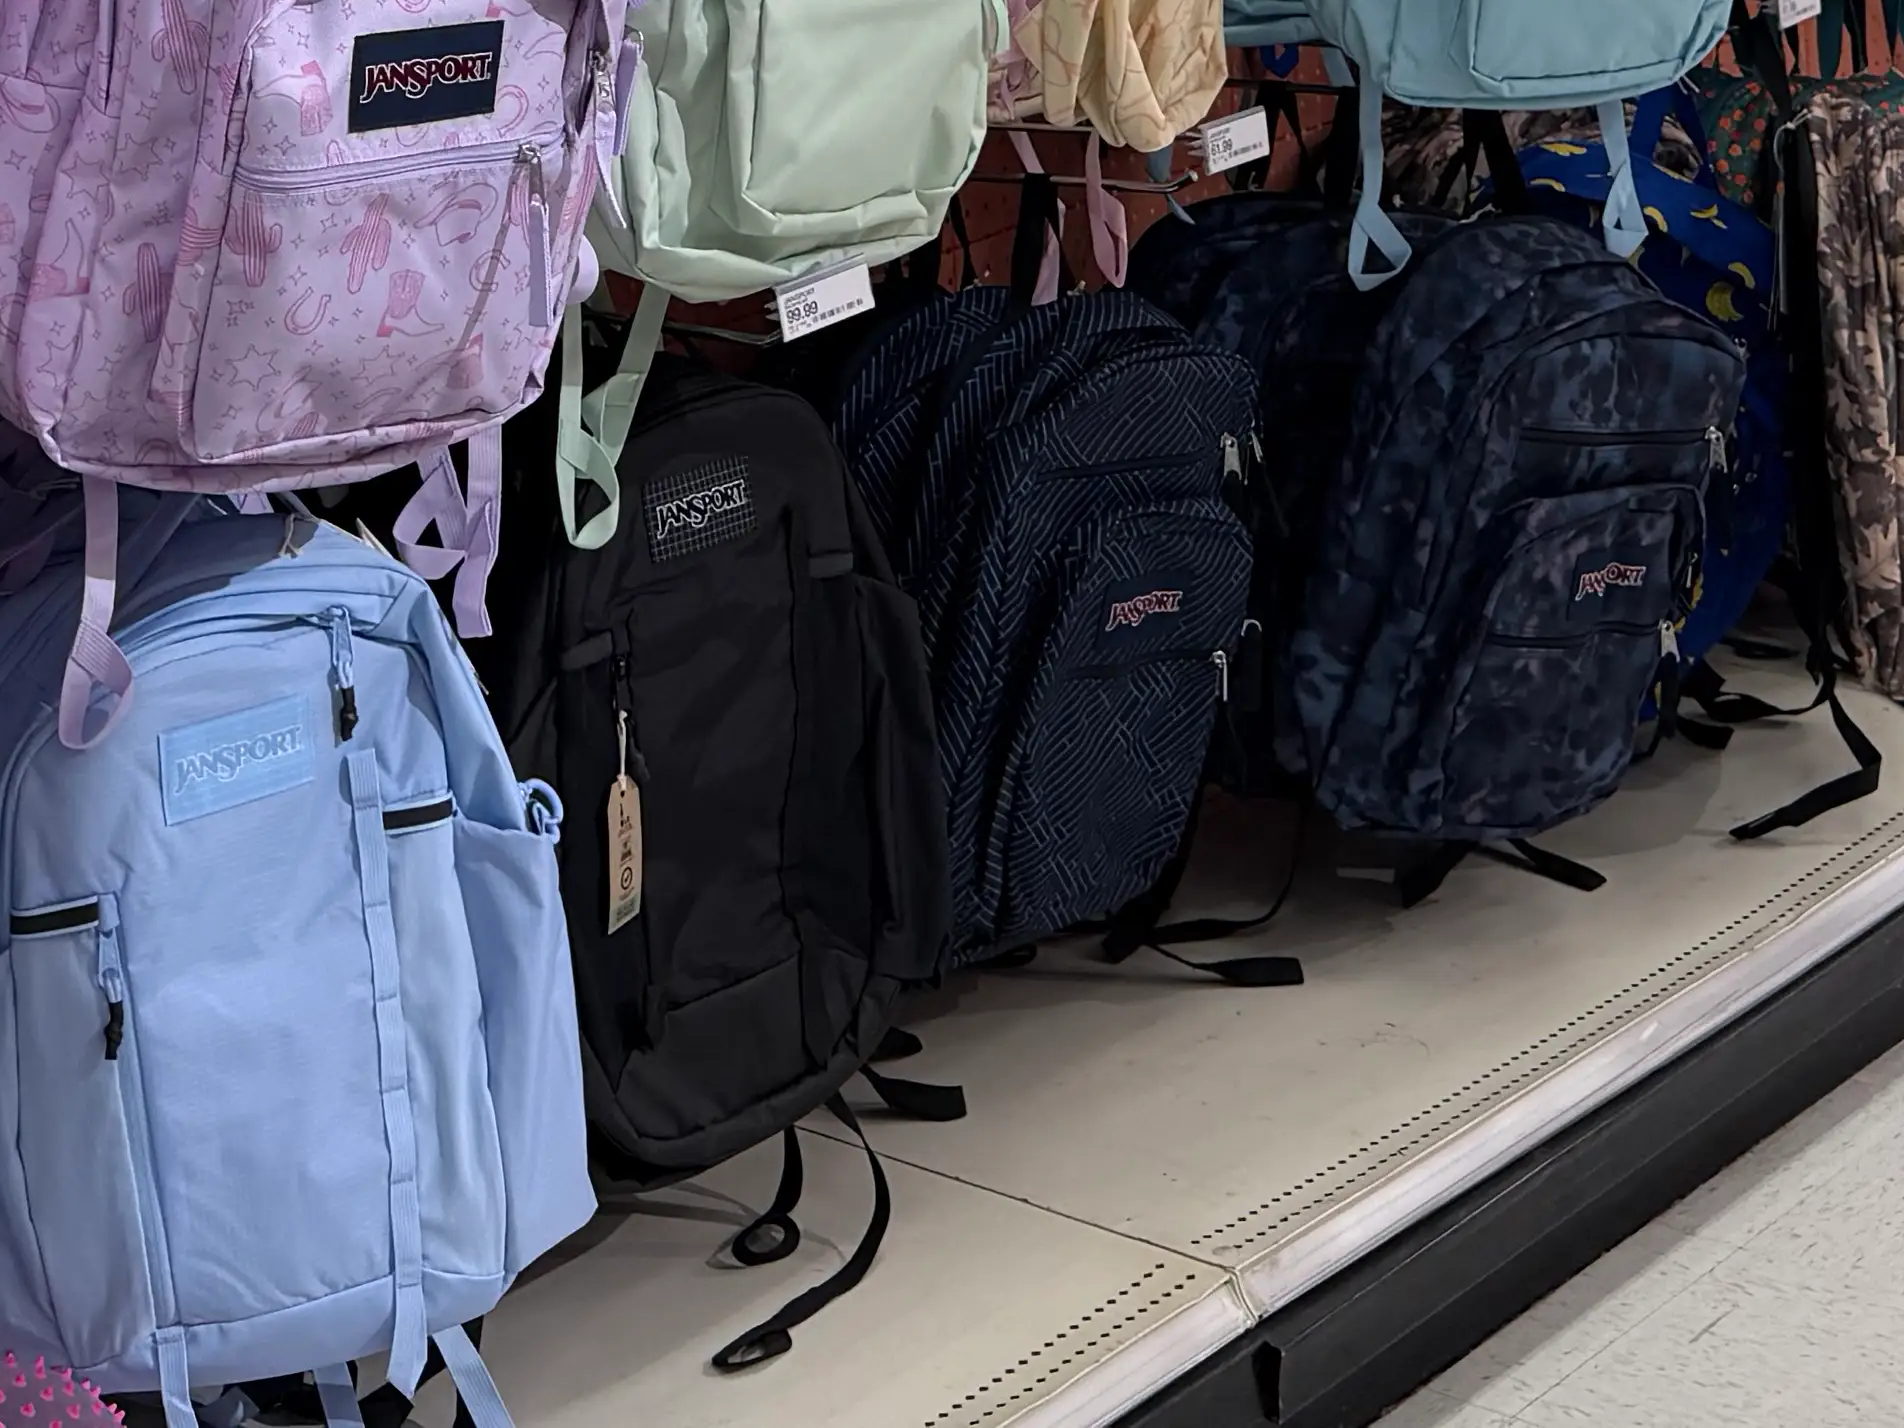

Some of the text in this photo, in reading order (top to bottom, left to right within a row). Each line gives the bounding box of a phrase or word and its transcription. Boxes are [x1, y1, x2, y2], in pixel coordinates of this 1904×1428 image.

[359, 51, 493, 104] JANSPORT
[656, 479, 746, 539] JANSPORT
[173, 724, 303, 796] JANSPORT
